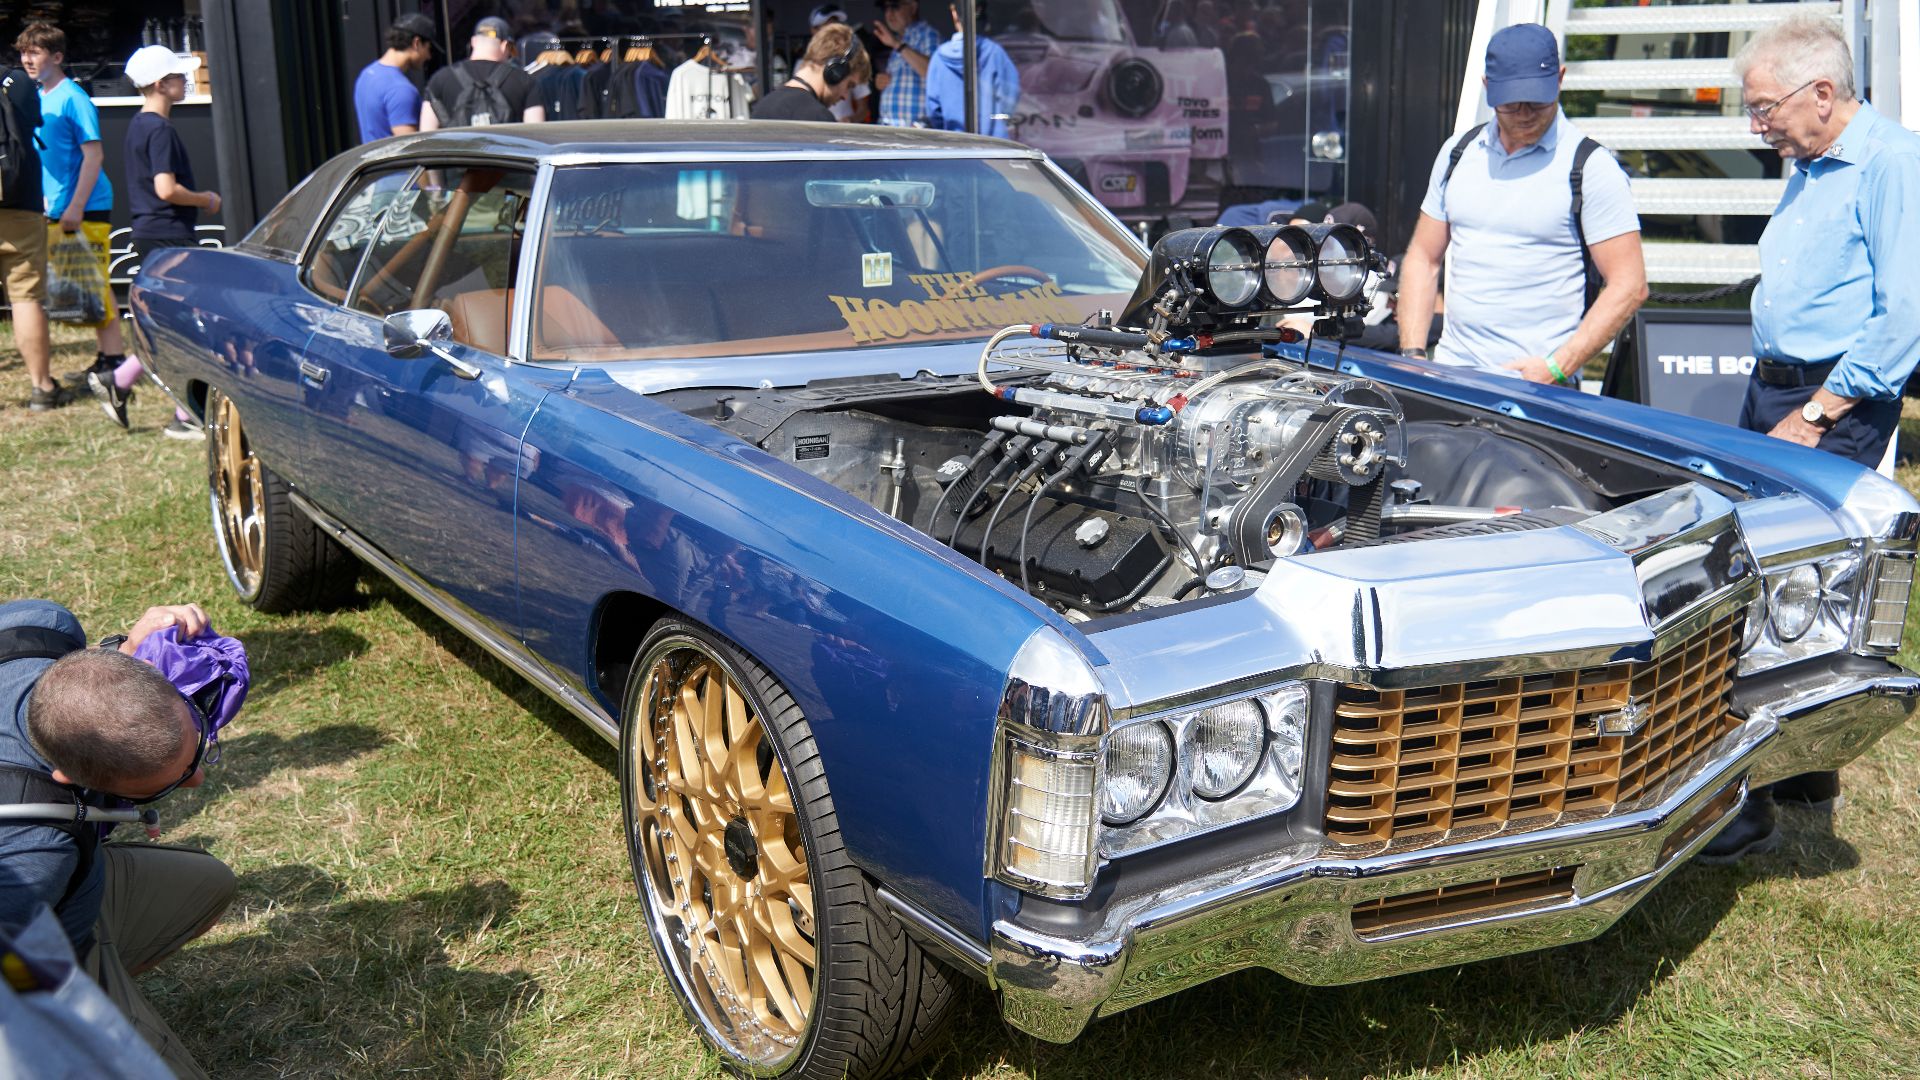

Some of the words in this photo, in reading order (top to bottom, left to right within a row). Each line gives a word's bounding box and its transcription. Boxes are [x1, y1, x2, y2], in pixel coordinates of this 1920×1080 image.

[1177, 97, 1209, 108] TOYO
[1183, 109, 1220, 118] TIRES
[908, 271, 988, 301] THE
[829, 281, 1083, 343] HOONIGANS
[1658, 355, 1713, 374] THE
